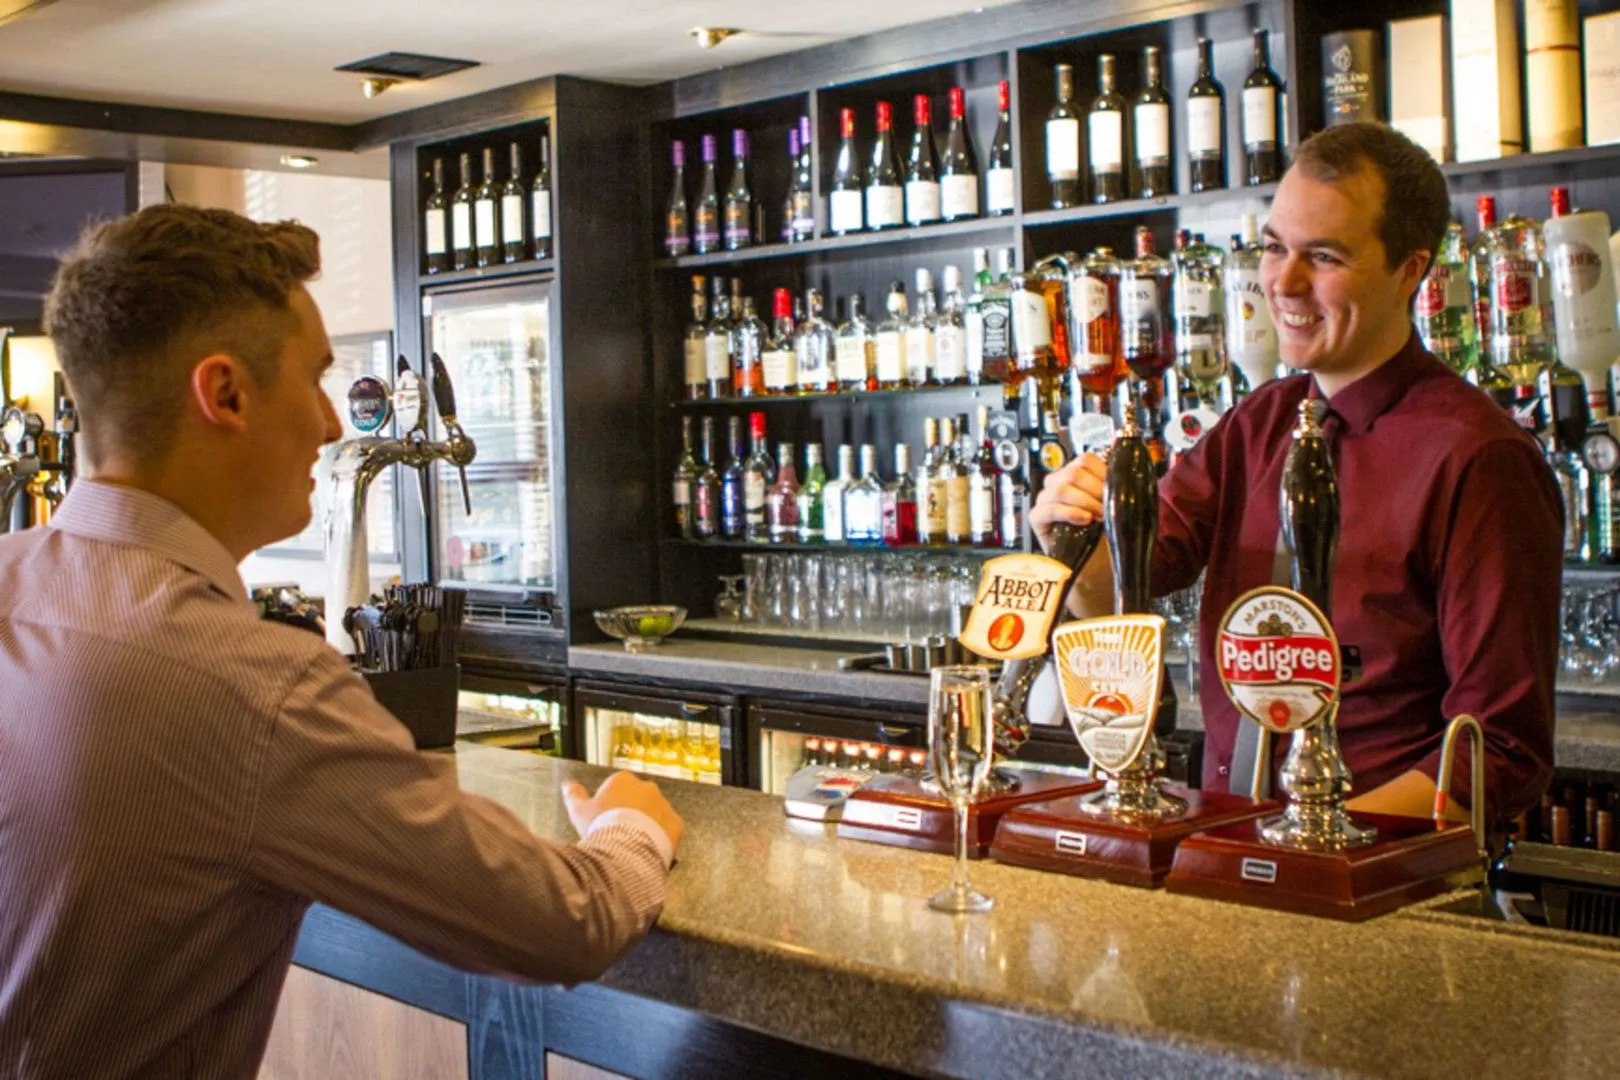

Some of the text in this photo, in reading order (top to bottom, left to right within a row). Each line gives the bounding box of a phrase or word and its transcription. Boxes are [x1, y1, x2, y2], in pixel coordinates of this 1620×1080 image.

[979, 575, 1059, 612] ABBOT
[1001, 598, 1036, 611] ALE
[1243, 600, 1307, 631] MARSTON'S
[1069, 646, 1146, 679] GOLD
[1222, 640, 1333, 681] Pedigree
